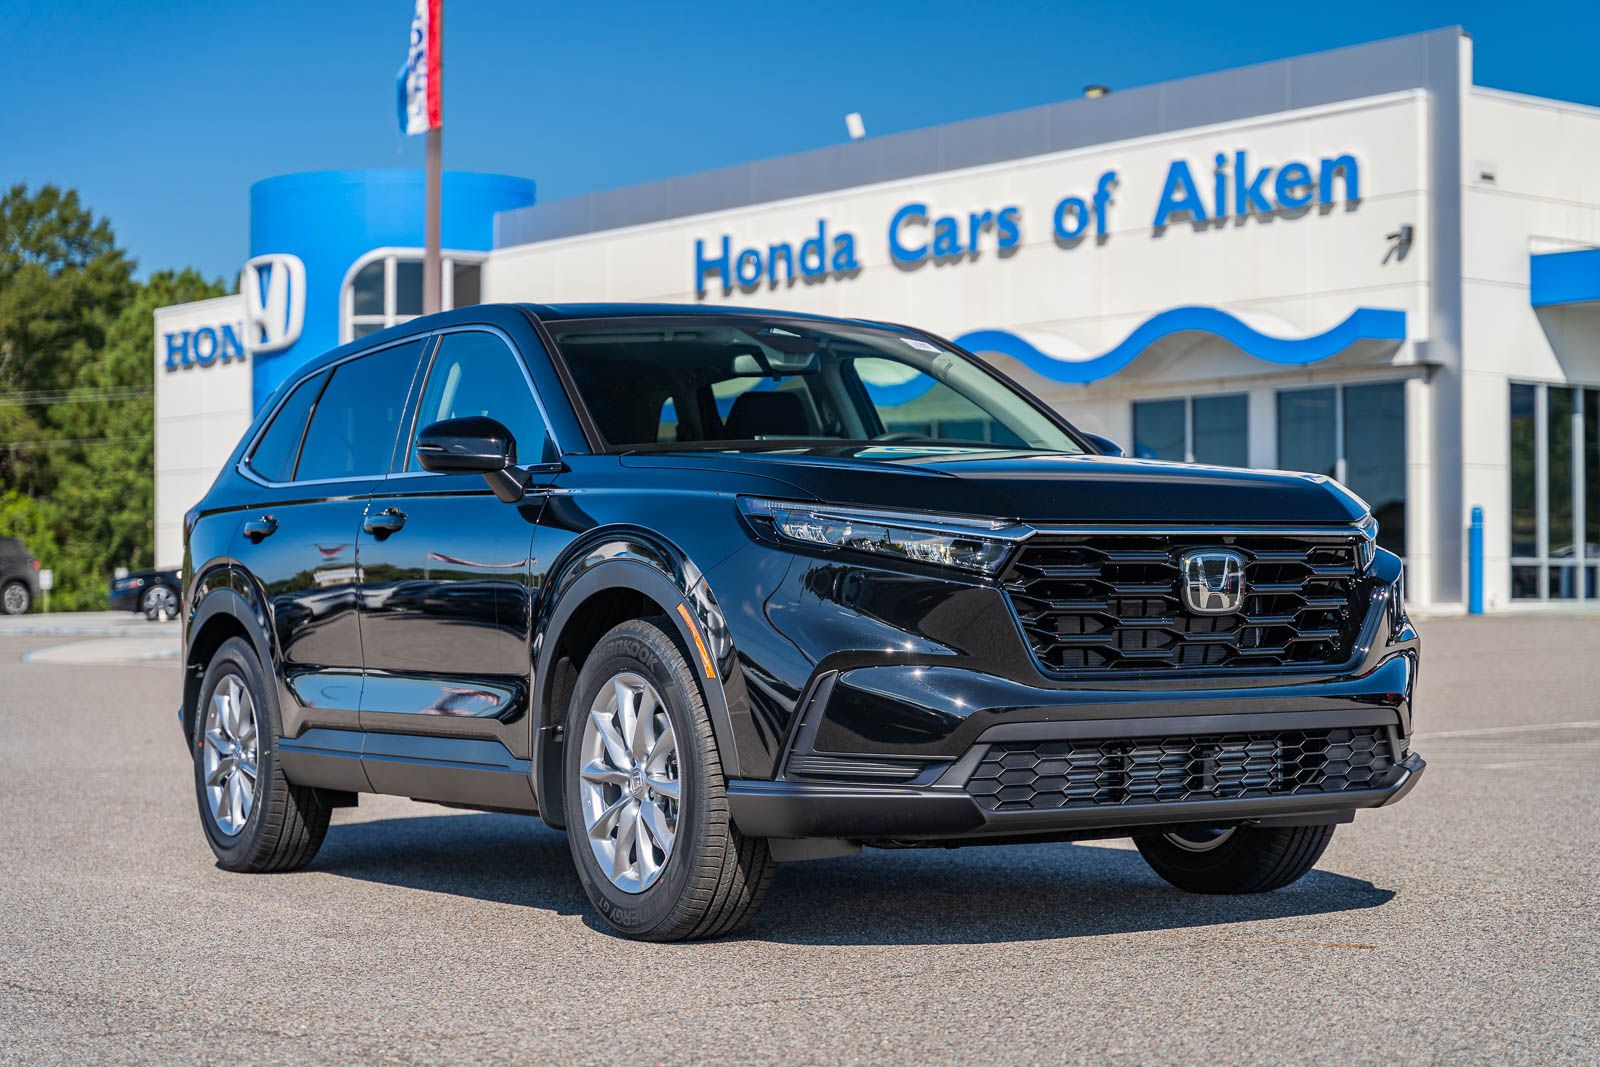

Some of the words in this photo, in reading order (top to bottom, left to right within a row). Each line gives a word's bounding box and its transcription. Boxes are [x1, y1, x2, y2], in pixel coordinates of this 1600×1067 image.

[695, 219, 860, 294] Honda
[889, 203, 1021, 263] Cars
[1053, 171, 1118, 240] of
[1153, 150, 1359, 229] Aiken
